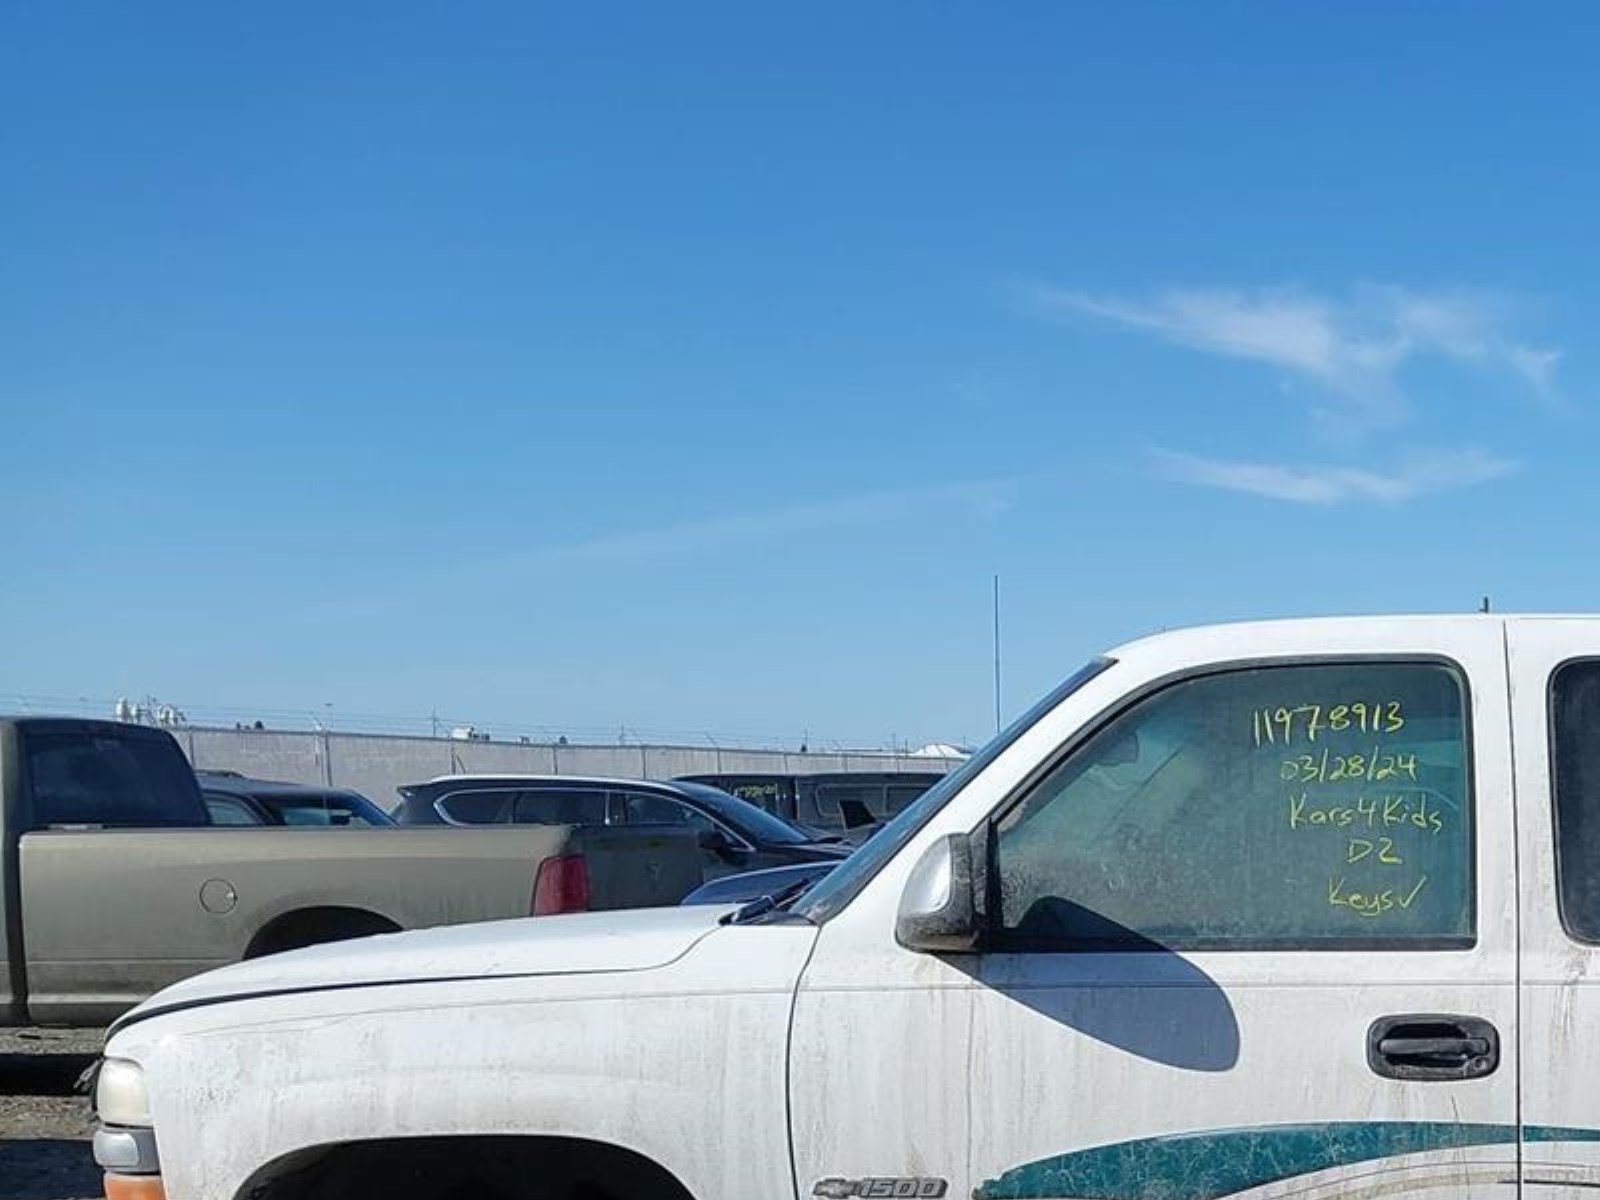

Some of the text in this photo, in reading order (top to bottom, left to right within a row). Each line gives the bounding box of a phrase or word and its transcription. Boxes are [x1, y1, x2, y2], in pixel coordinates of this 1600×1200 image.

[1253, 702, 1404, 747] 11978913
[1280, 746, 1417, 782] 03/28/24
[1328, 877, 1394, 917] Keys
[858, 1177, 947, 1199] 1500
